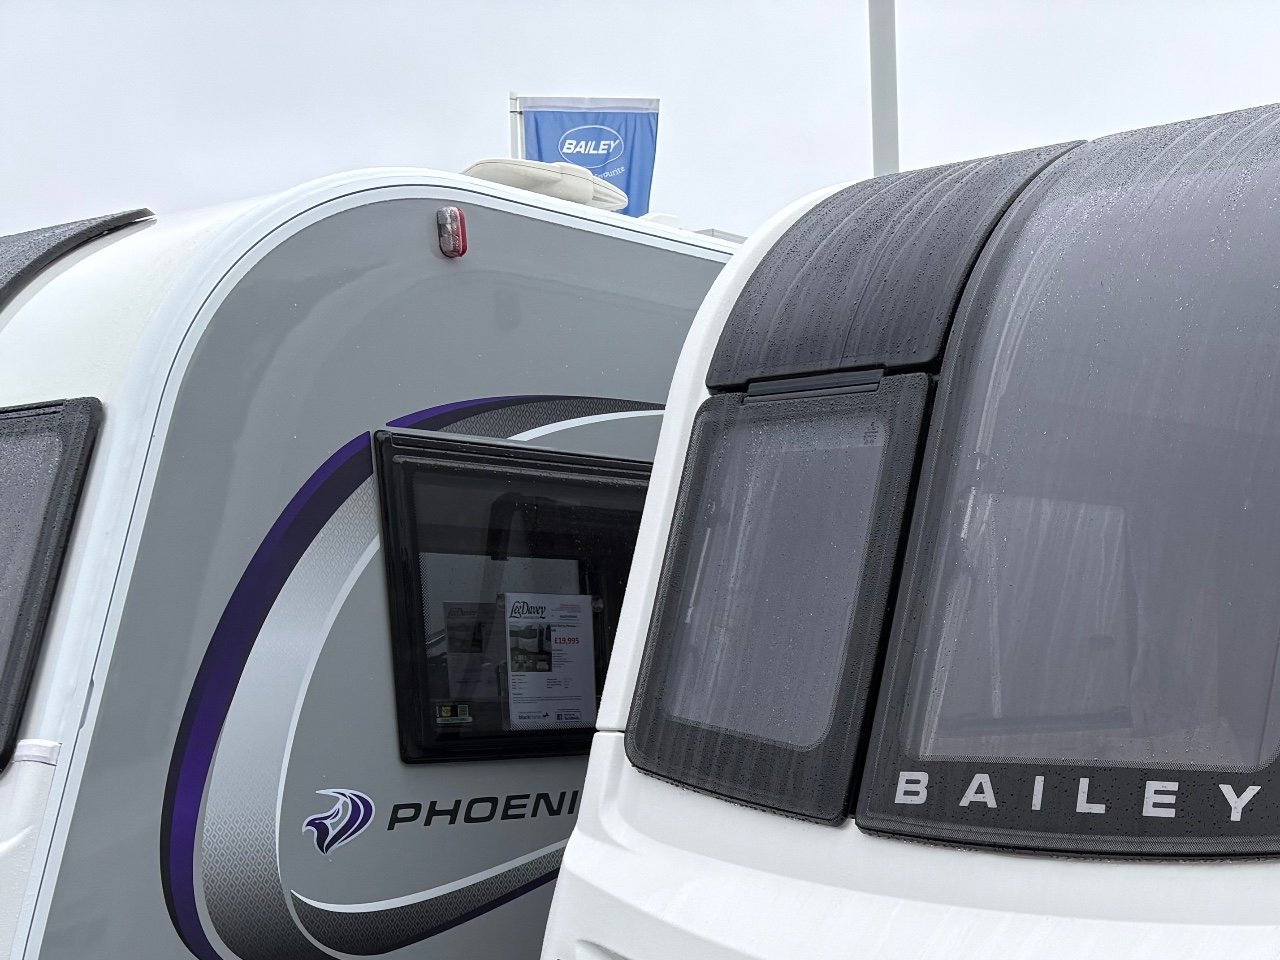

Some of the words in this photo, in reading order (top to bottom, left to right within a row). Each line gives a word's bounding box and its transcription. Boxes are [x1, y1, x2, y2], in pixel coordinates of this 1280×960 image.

[562, 139, 620, 154] BAILEY
[554, 636, 580, 645] £19,995
[894, 770, 1262, 822] BAILEY
[387, 790, 580, 831] PHOENI
